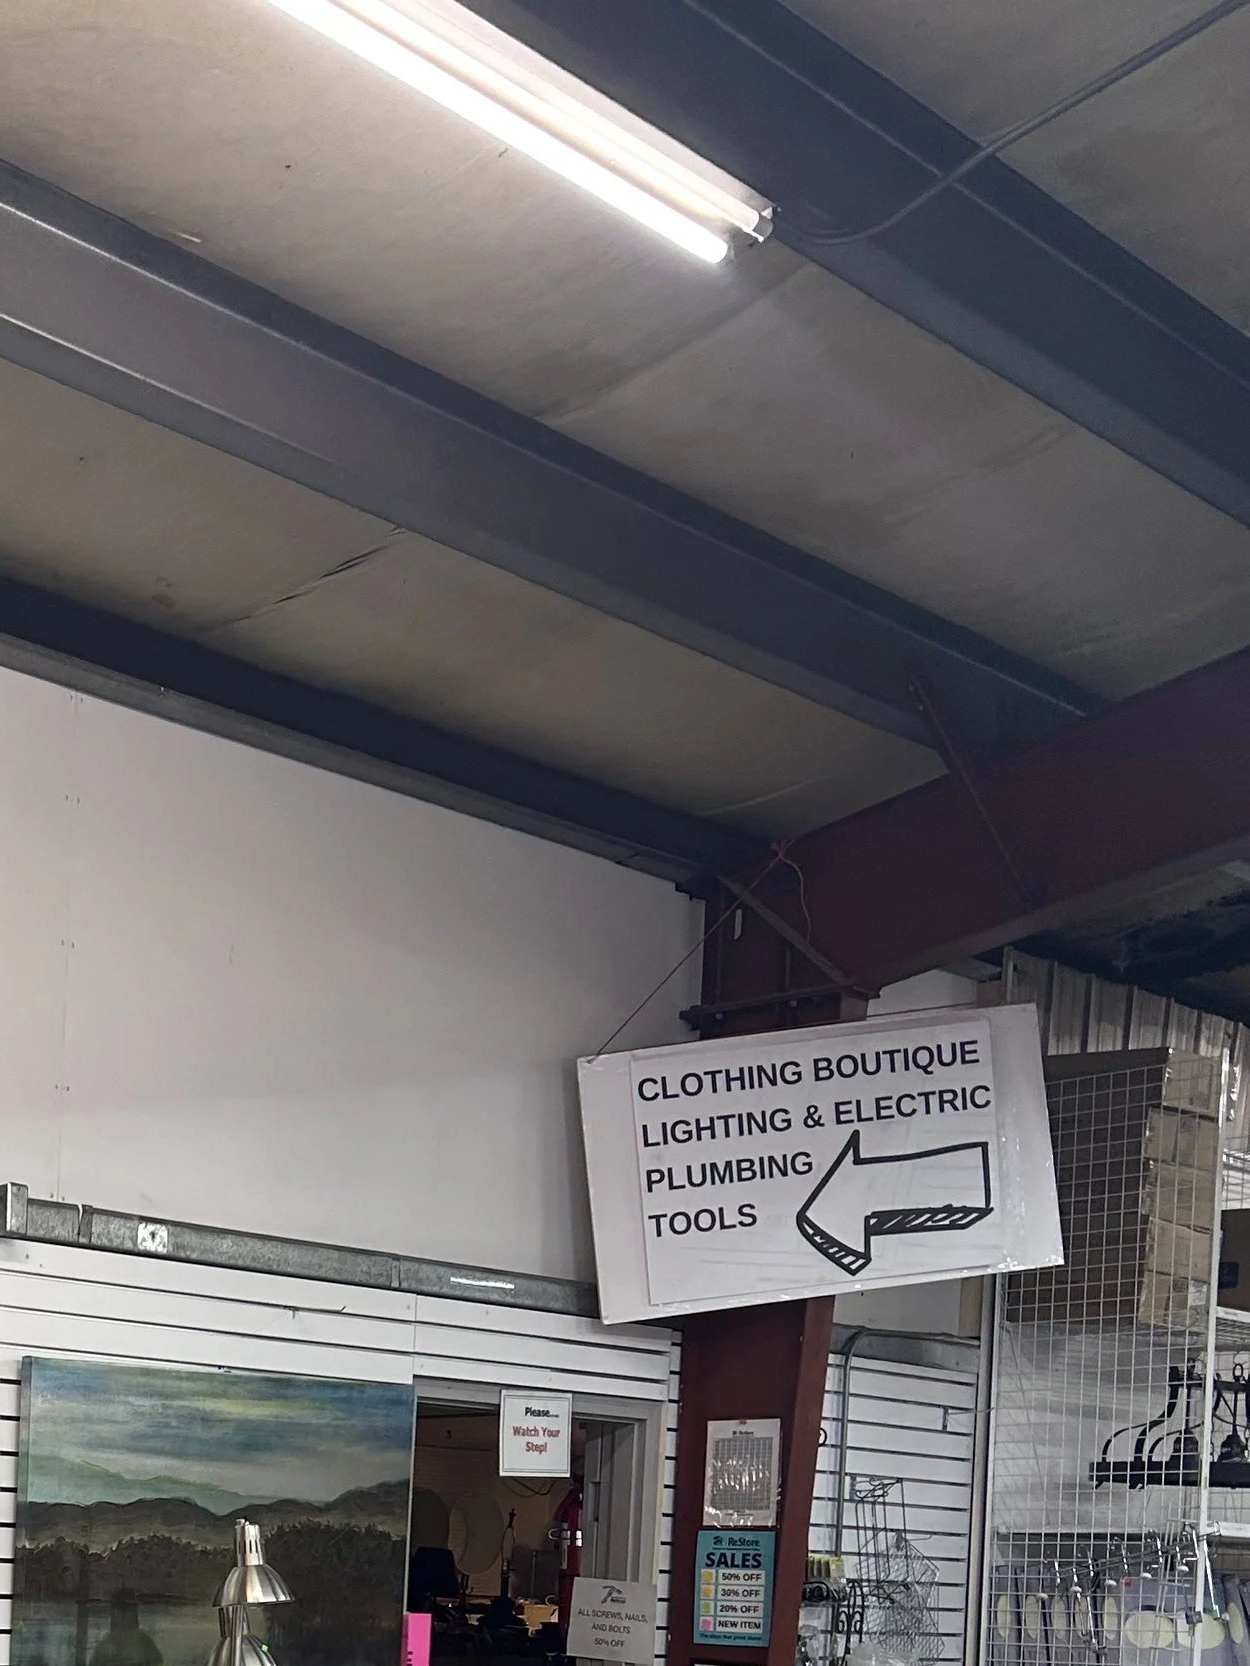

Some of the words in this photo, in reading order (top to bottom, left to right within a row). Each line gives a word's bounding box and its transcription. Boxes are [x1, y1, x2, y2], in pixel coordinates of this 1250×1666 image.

[637, 1061, 803, 1102] CLOTHING
[812, 1039, 980, 1082] BOUTIQUE
[642, 1108, 793, 1148] LIGHTING
[802, 1104, 825, 1129] &
[834, 1084, 992, 1126] ELECTRIC
[646, 1151, 814, 1194] PLUMBING
[647, 1203, 758, 1238] TOOLS
[512, 1426, 540, 1438] Watch
[541, 1427, 561, 1438] Your
[525, 1441, 548, 1455] Step!
[727, 1536, 760, 1547] ReStore
[705, 1552, 763, 1569] SALES
[721, 1573, 740, 1582] 50%
[742, 1573, 763, 1582] OFF
[720, 1588, 739, 1597] 30%
[741, 1589, 762, 1598] OFF
[577, 1608, 590, 1617] ALL
[719, 1604, 738, 1613] 20%
[740, 1605, 760, 1614] OFF
[591, 1622, 607, 1632] AND
[608, 1624, 631, 1634] BOLTS
[717, 1620, 738, 1629] NEW
[740, 1621, 762, 1630] ITEM
[594, 1637, 609, 1647] 50%
[610, 1639, 626, 1648] OFF
